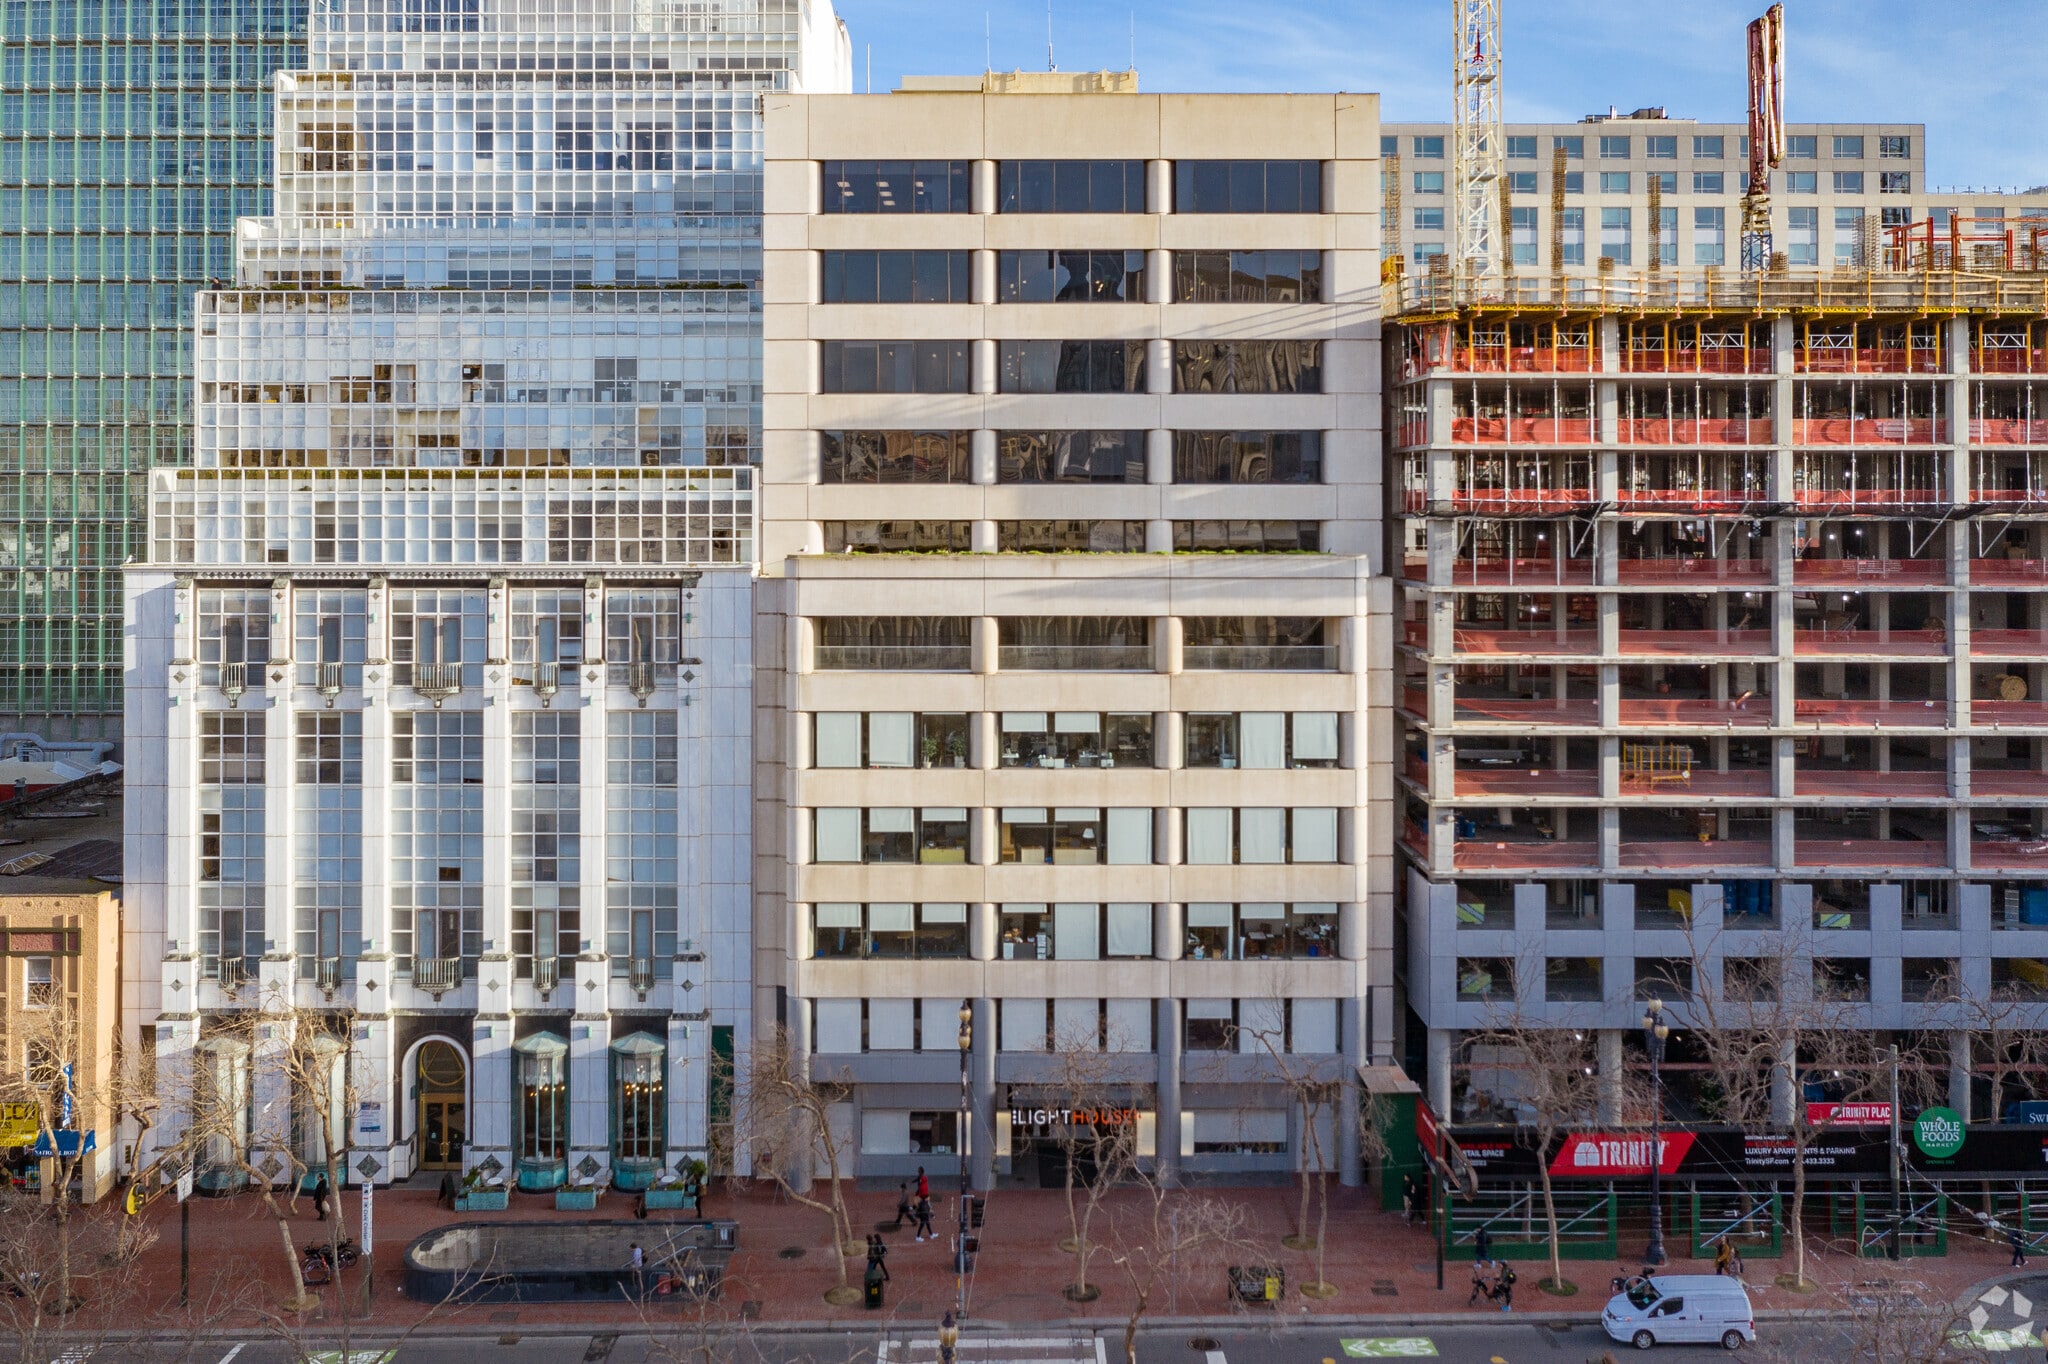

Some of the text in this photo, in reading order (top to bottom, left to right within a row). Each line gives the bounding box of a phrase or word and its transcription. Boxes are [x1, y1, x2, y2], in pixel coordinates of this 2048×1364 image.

[1842, 1106, 1891, 1118] TRINITY PLAC
[1919, 1121, 1960, 1132] WHOLE
[1921, 1132, 1960, 1142] FOODS
[1600, 1141, 1666, 1166] TRINITY
